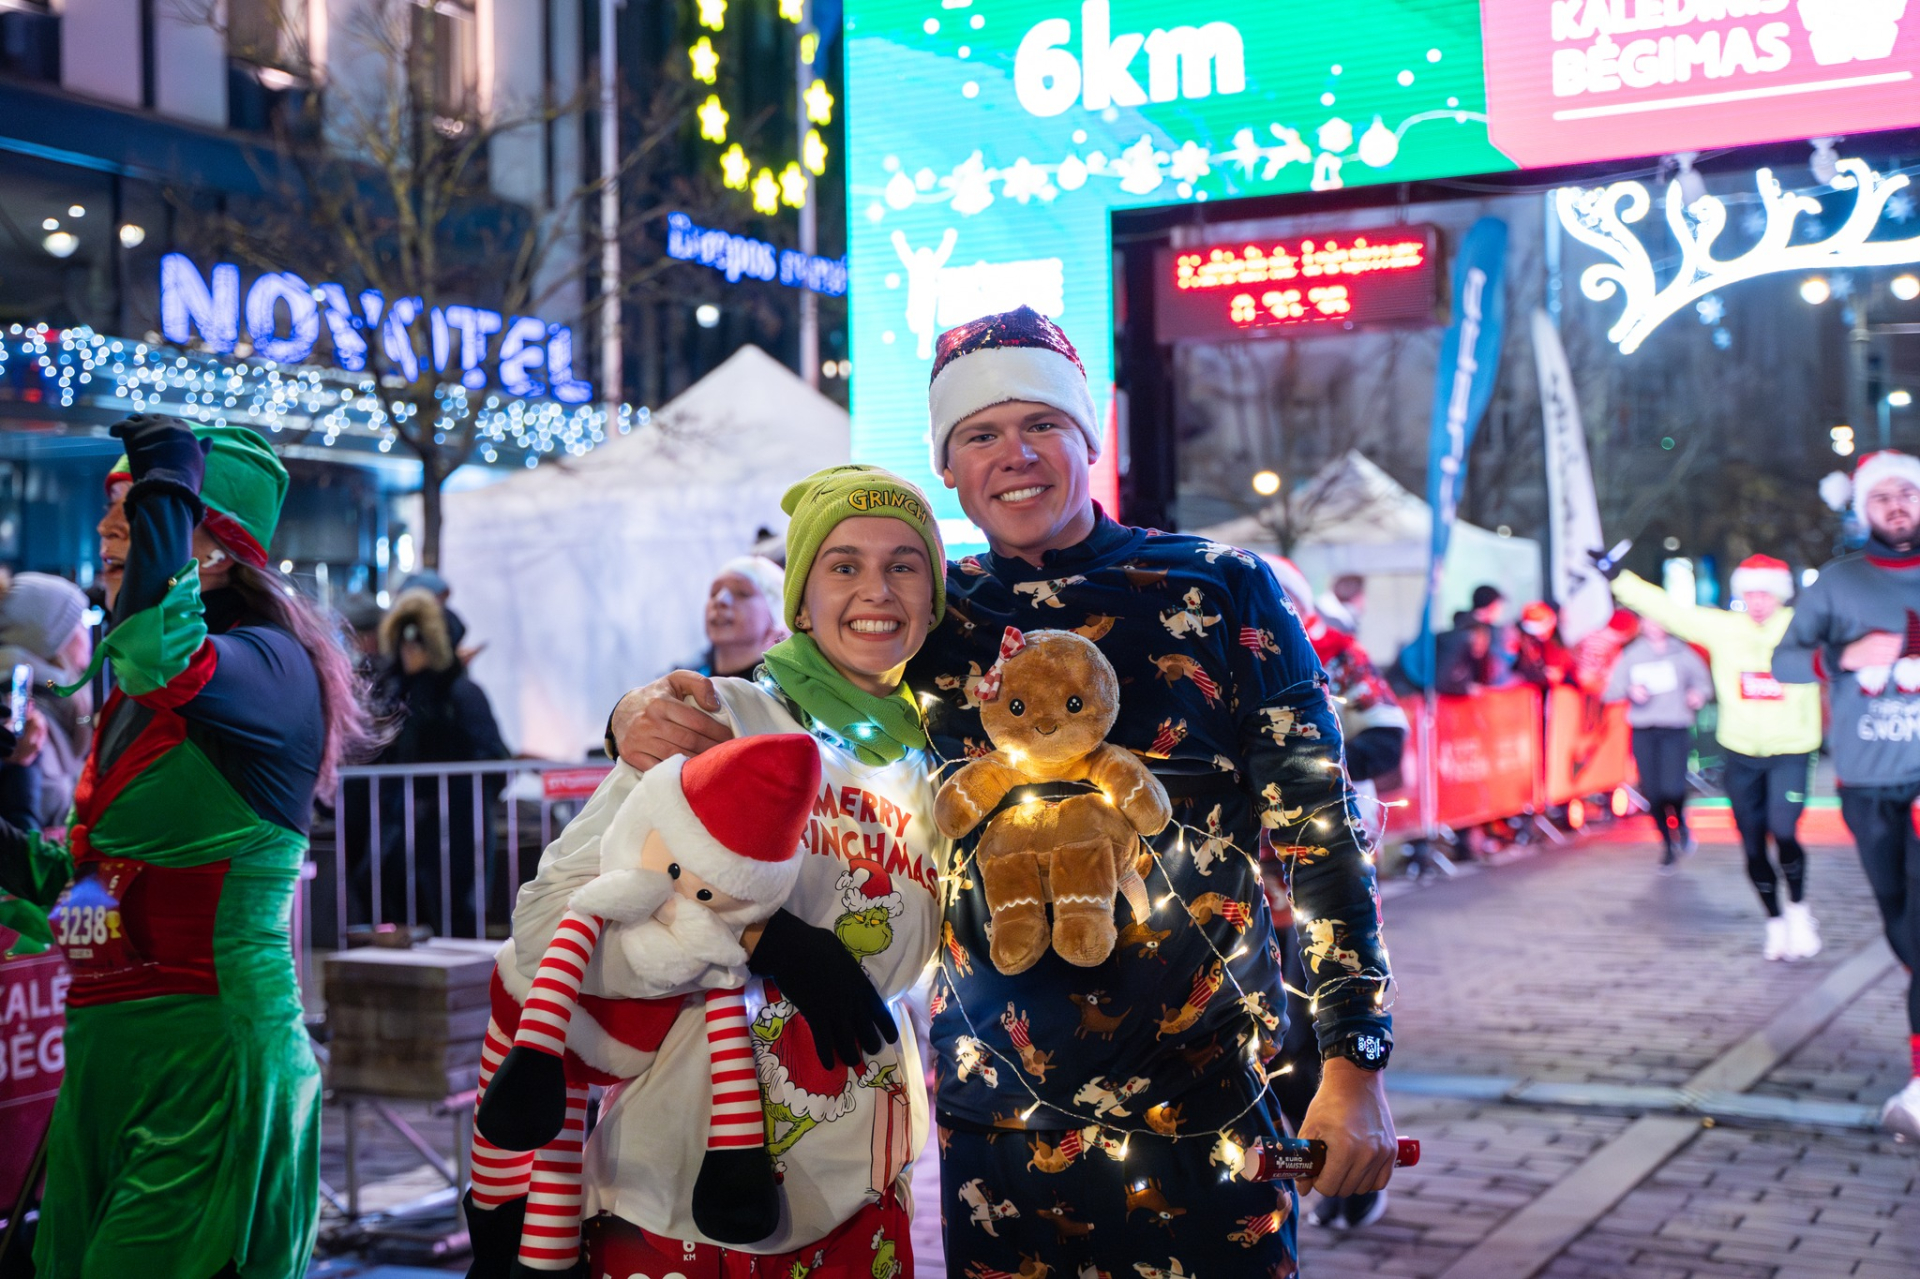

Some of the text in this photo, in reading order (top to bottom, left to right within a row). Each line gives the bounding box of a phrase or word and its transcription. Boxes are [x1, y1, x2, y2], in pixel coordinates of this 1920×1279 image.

[1013, 0, 1246, 117] 6km
[1552, 34, 1791, 98] BĖGIMAS
[848, 488, 927, 526] GRINCH
[812, 782, 912, 838] MERRY
[57, 905, 108, 946] 3238
[683, 1253, 696, 1261] KM
